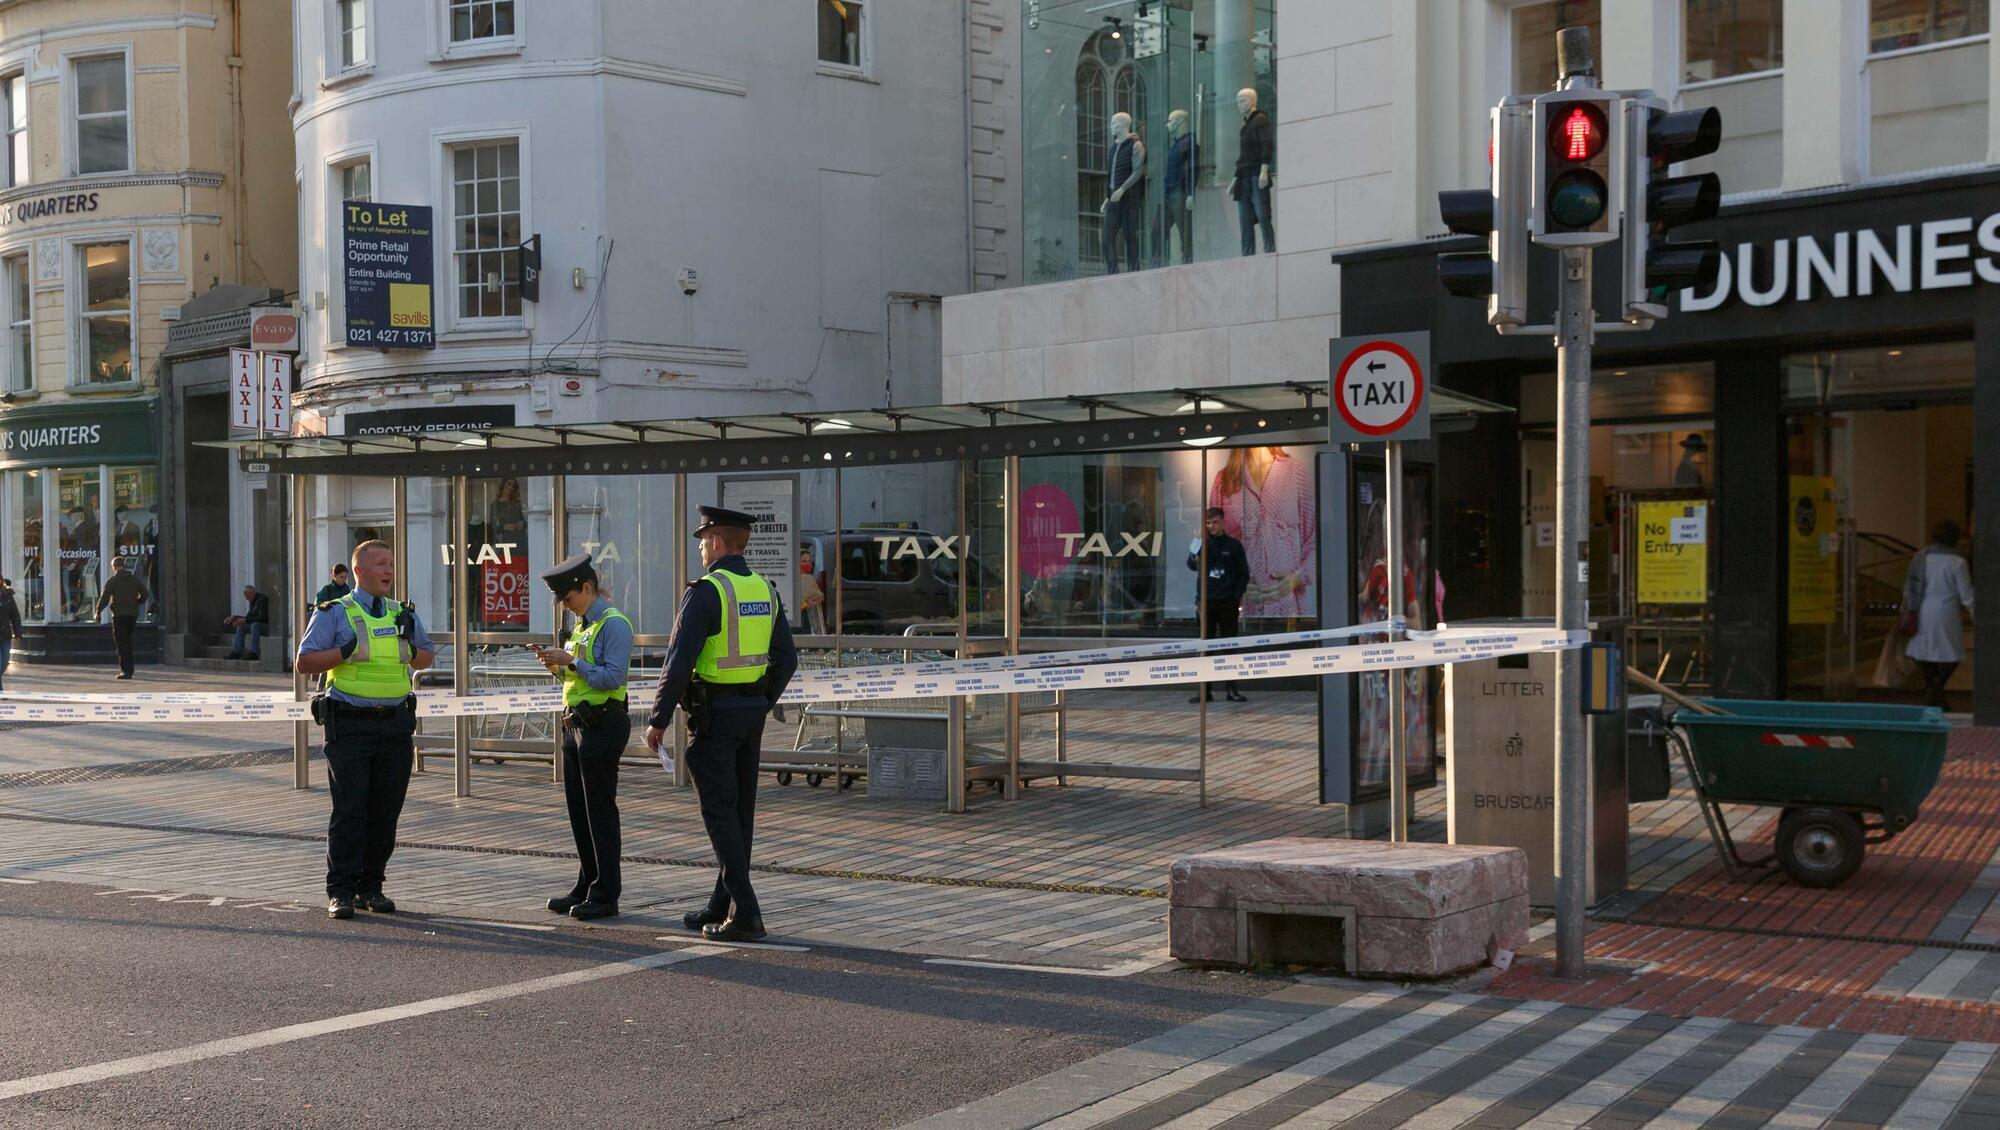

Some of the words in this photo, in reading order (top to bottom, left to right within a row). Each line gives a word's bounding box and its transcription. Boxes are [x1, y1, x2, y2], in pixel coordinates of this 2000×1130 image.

[18, 192, 98, 223] QUARTERS
[348, 207, 372, 224] To
[378, 208, 408, 226] Let
[348, 239, 378, 250] Prime
[380, 241, 409, 252] Retail
[349, 250, 408, 265] Opportunity
[349, 268, 374, 277] Entire
[376, 269, 411, 281] Building
[526, 266, 537, 283] DP
[393, 312, 429, 325] savills
[256, 324, 294, 334] Evans
[350, 328, 371, 340] 021
[376, 330, 399, 342] 427
[403, 331, 432, 342] 1371
[239, 354, 251, 425] TAXI
[272, 359, 283, 428] TAXI
[1348, 381, 1404, 406] TAXI
[20, 424, 101, 450] QUARTERS
[760, 524, 787, 533] SHELTER
[1644, 523, 1665, 535] No
[120, 544, 155, 556] SUIT
[873, 535, 971, 560] TAXI
[1056, 531, 1163, 557] TAXI
[1645, 540, 1685, 556] Entry
[56, 548, 96, 559] Occasions
[486, 572, 529, 594] 50%
[486, 596, 529, 610] SALE
[741, 604, 769, 614] GARDA
[1482, 682, 1544, 696] LITTER
[1474, 794, 1554, 809] BRUSCAR
